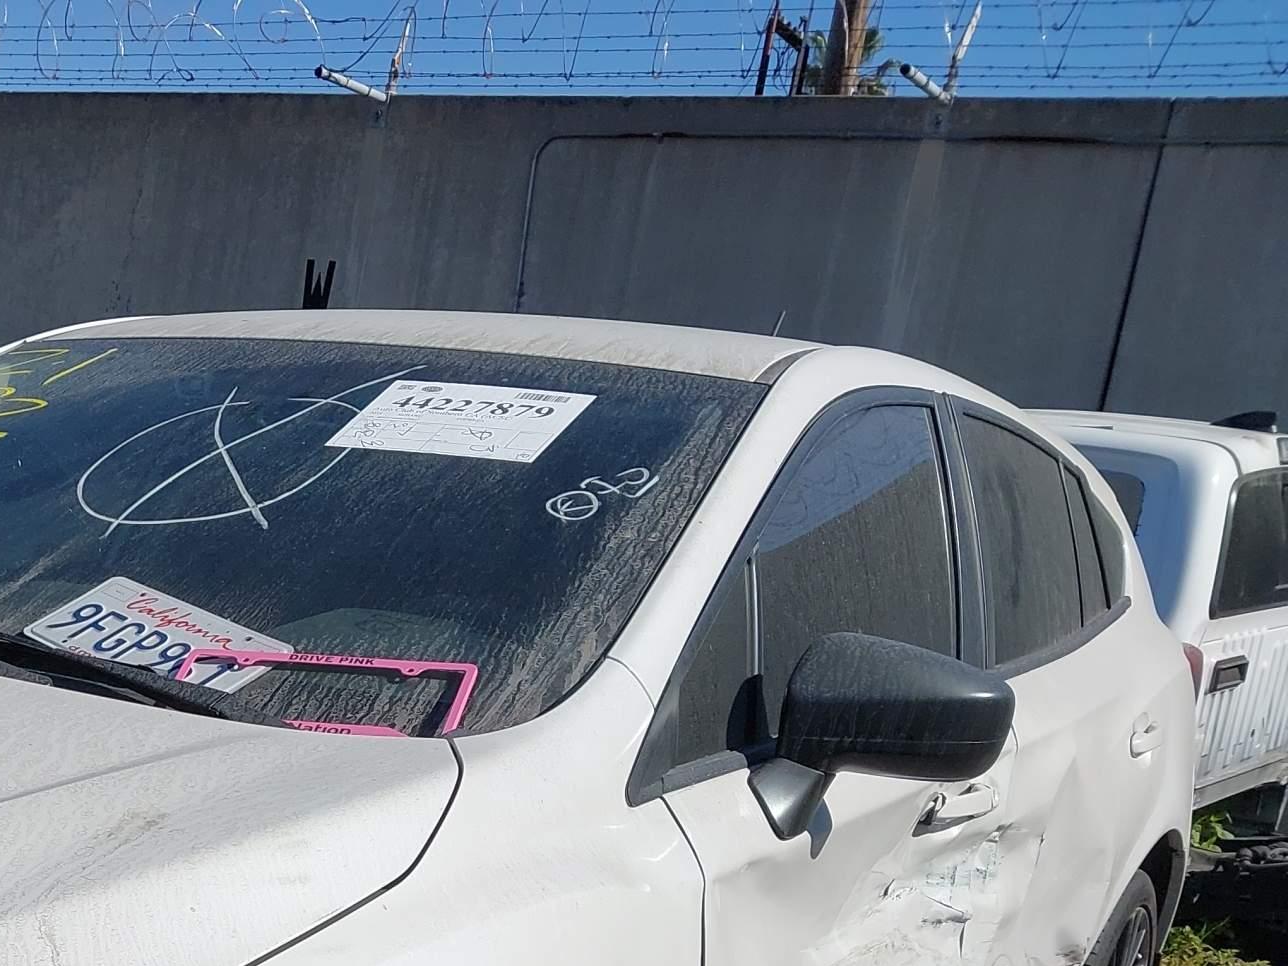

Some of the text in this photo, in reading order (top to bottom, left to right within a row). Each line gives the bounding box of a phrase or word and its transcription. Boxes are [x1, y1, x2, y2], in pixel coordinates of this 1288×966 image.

[303, 258, 337, 309] W
[392, 395, 555, 419] 44227879
[126, 597, 233, 650] California
[288, 653, 375, 666] DRIVE PINK
